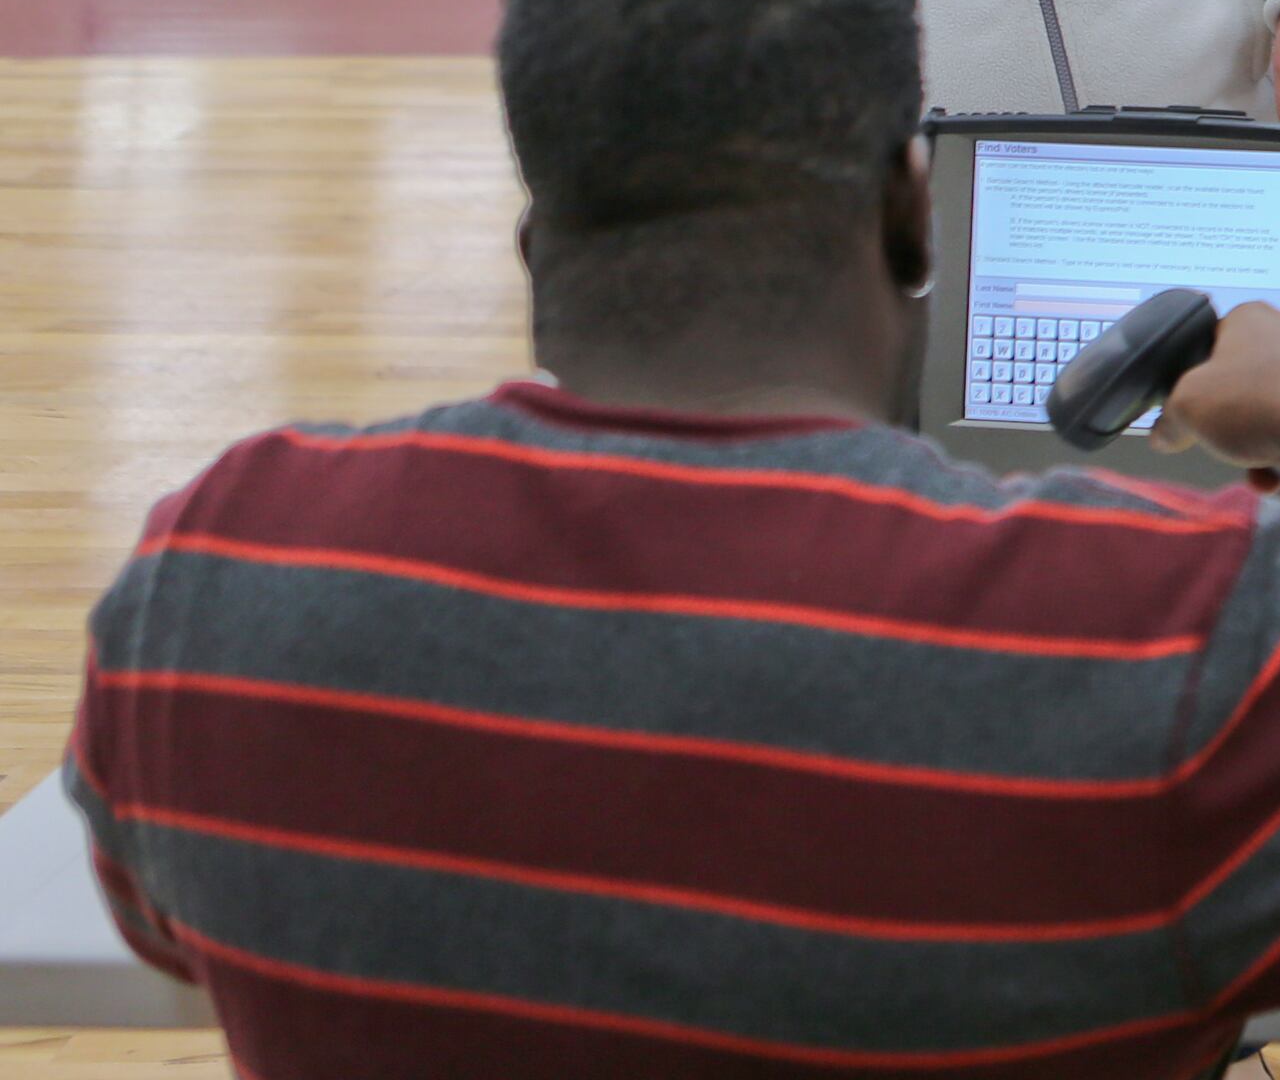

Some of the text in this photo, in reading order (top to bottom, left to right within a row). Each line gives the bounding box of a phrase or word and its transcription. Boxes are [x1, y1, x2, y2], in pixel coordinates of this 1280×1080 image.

[977, 143, 1038, 154] Find Voters
[998, 345, 1008, 355] W
